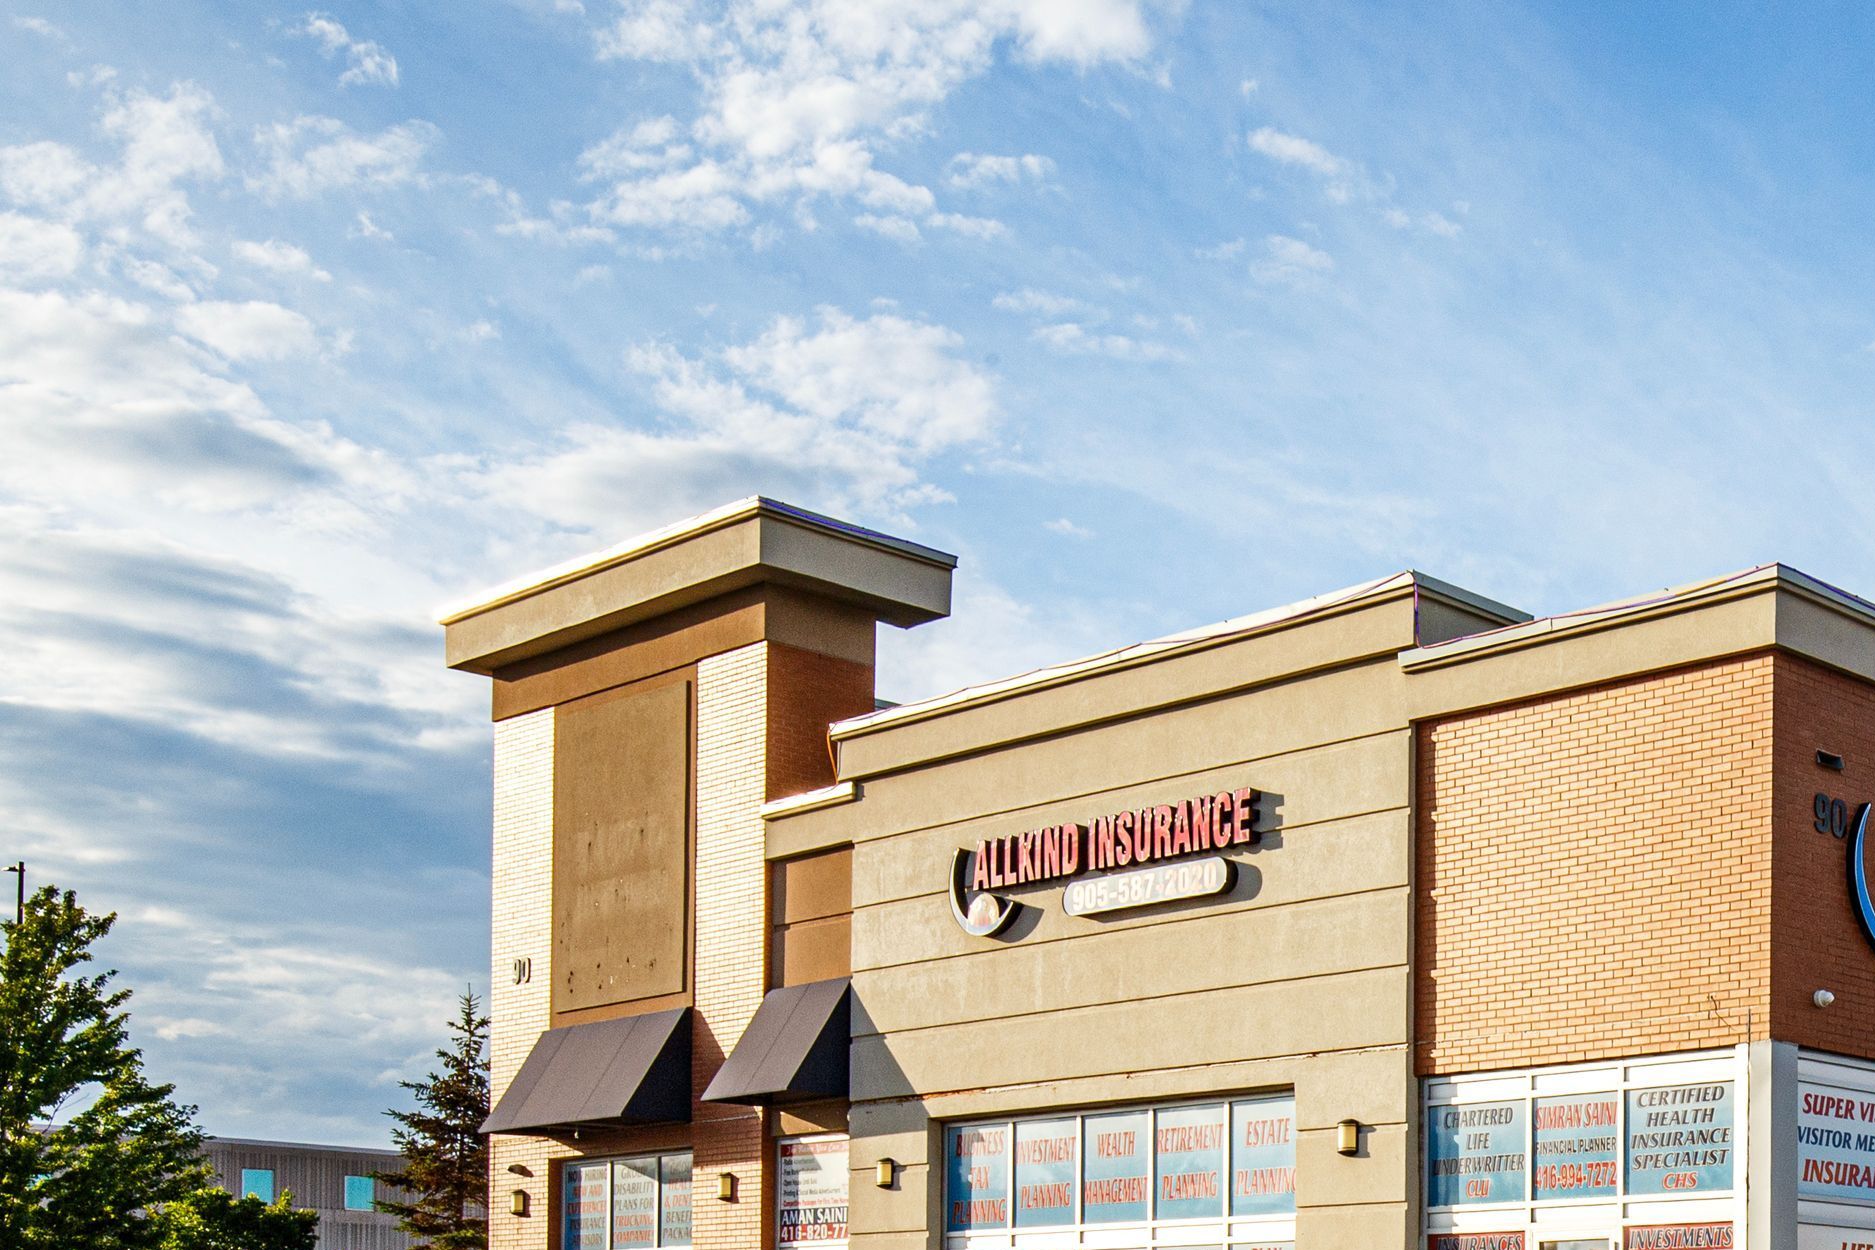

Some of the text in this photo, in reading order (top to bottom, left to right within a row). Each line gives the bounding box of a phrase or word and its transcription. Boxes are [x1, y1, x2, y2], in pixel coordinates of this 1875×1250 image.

[1815, 793, 1847, 839] 90
[973, 787, 1251, 891] ALLKIND INSURANCE
[1072, 862, 1218, 913] 905-587-2020
[513, 957, 531, 984] 90
[1637, 1085, 1725, 1109] CERTIFIED
[1802, 1092, 1855, 1121] SUPER
[1443, 1106, 1514, 1130] CHARTERED
[1536, 1100, 1618, 1131] SIMRAN SAINI
[1647, 1107, 1716, 1128] HEALTH
[1097, 1130, 1136, 1159] WEALTH
[1157, 1123, 1223, 1153] RETIREMENT
[1246, 1117, 1291, 1147] ESTATE
[1466, 1132, 1490, 1151] LIFE
[1631, 1127, 1731, 1150] INSURANCE
[1797, 1125, 1852, 1150] VISITOR
[1536, 1135, 1617, 1156] FINANCIAL PLANNER
[1632, 1148, 1730, 1171] SPECIALIST
[1085, 1176, 1148, 1206] MANAGEMENT
[1161, 1170, 1218, 1200] PLANNING
[1466, 1178, 1490, 1198] CLU
[1662, 1171, 1698, 1190] CHS
[1020, 1182, 1071, 1210] PLANNING
[783, 1207, 848, 1226] AMAN SAINI
[1629, 1226, 1732, 1250] INVESTMENTS
